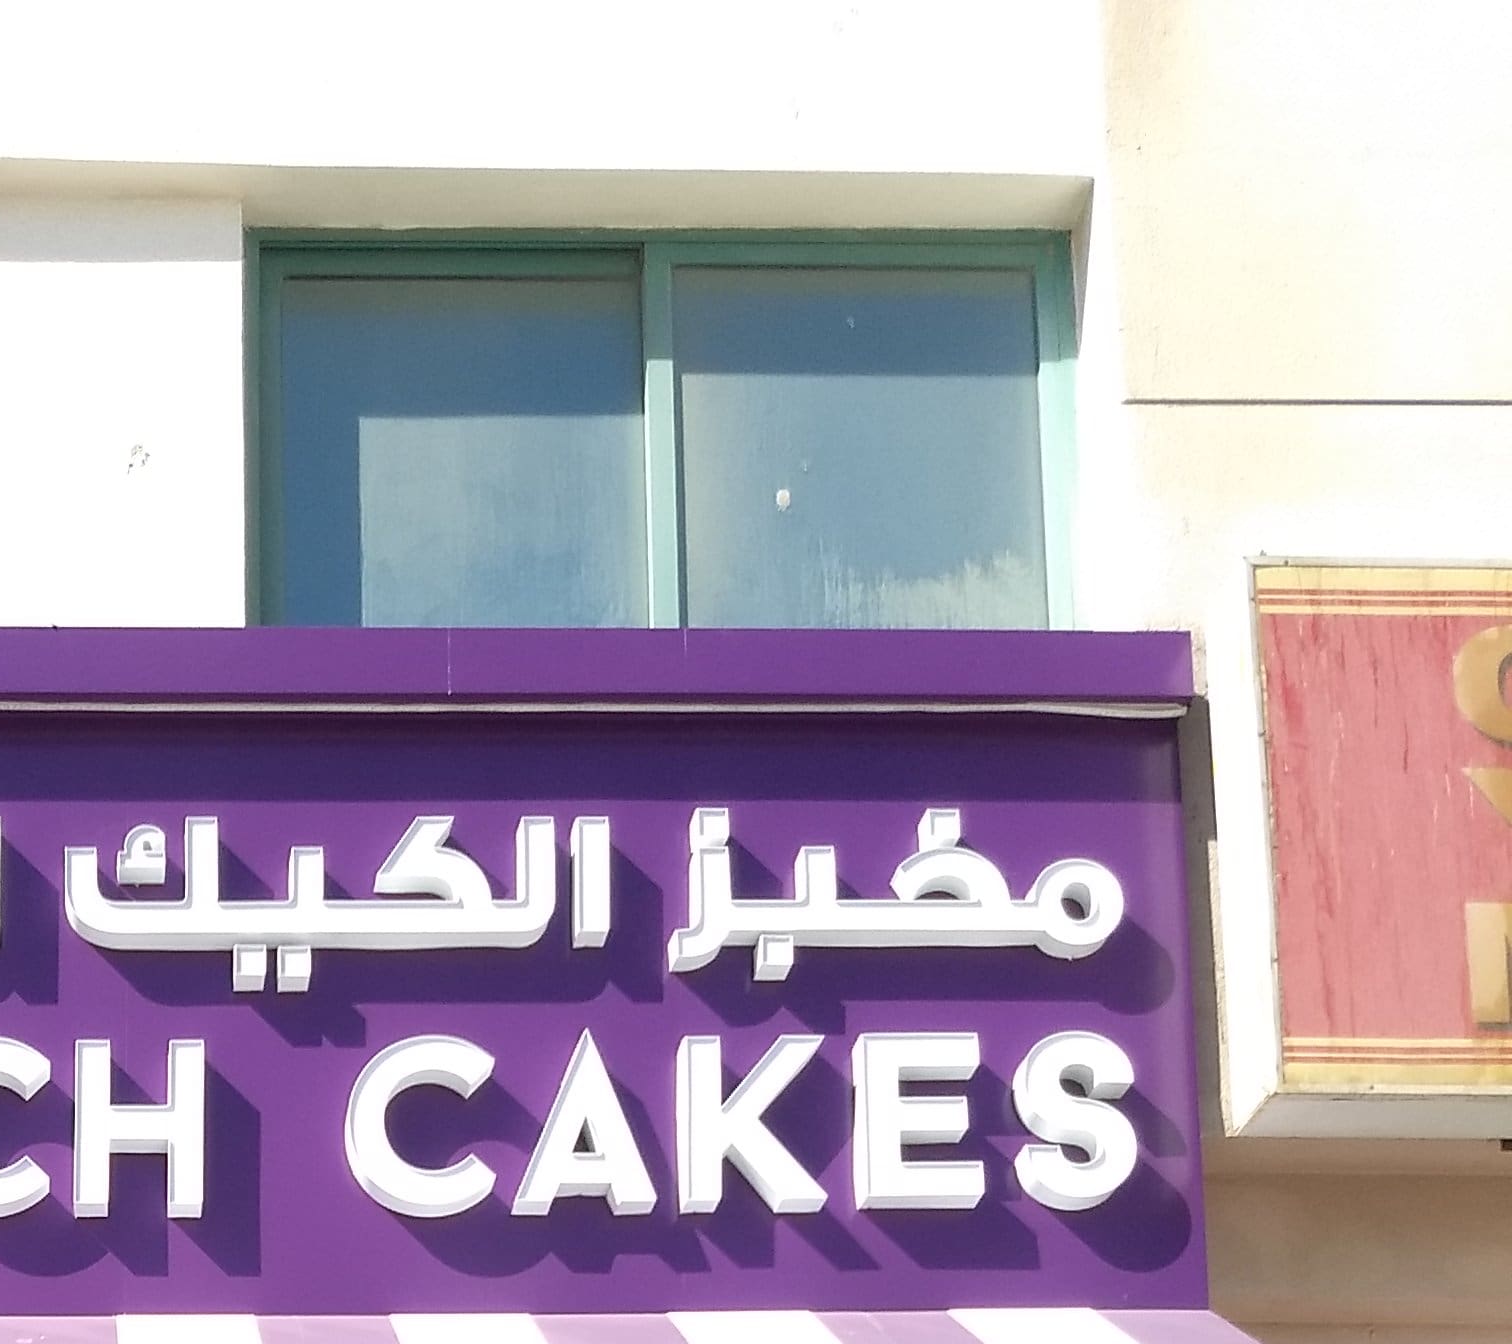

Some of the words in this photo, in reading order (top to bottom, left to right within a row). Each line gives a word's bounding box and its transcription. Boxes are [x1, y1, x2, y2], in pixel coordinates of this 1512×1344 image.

[65, 816, 610, 993] الكيك
[668, 808, 1124, 982] مخبز
[344, 1028, 1138, 1218] CAKES
